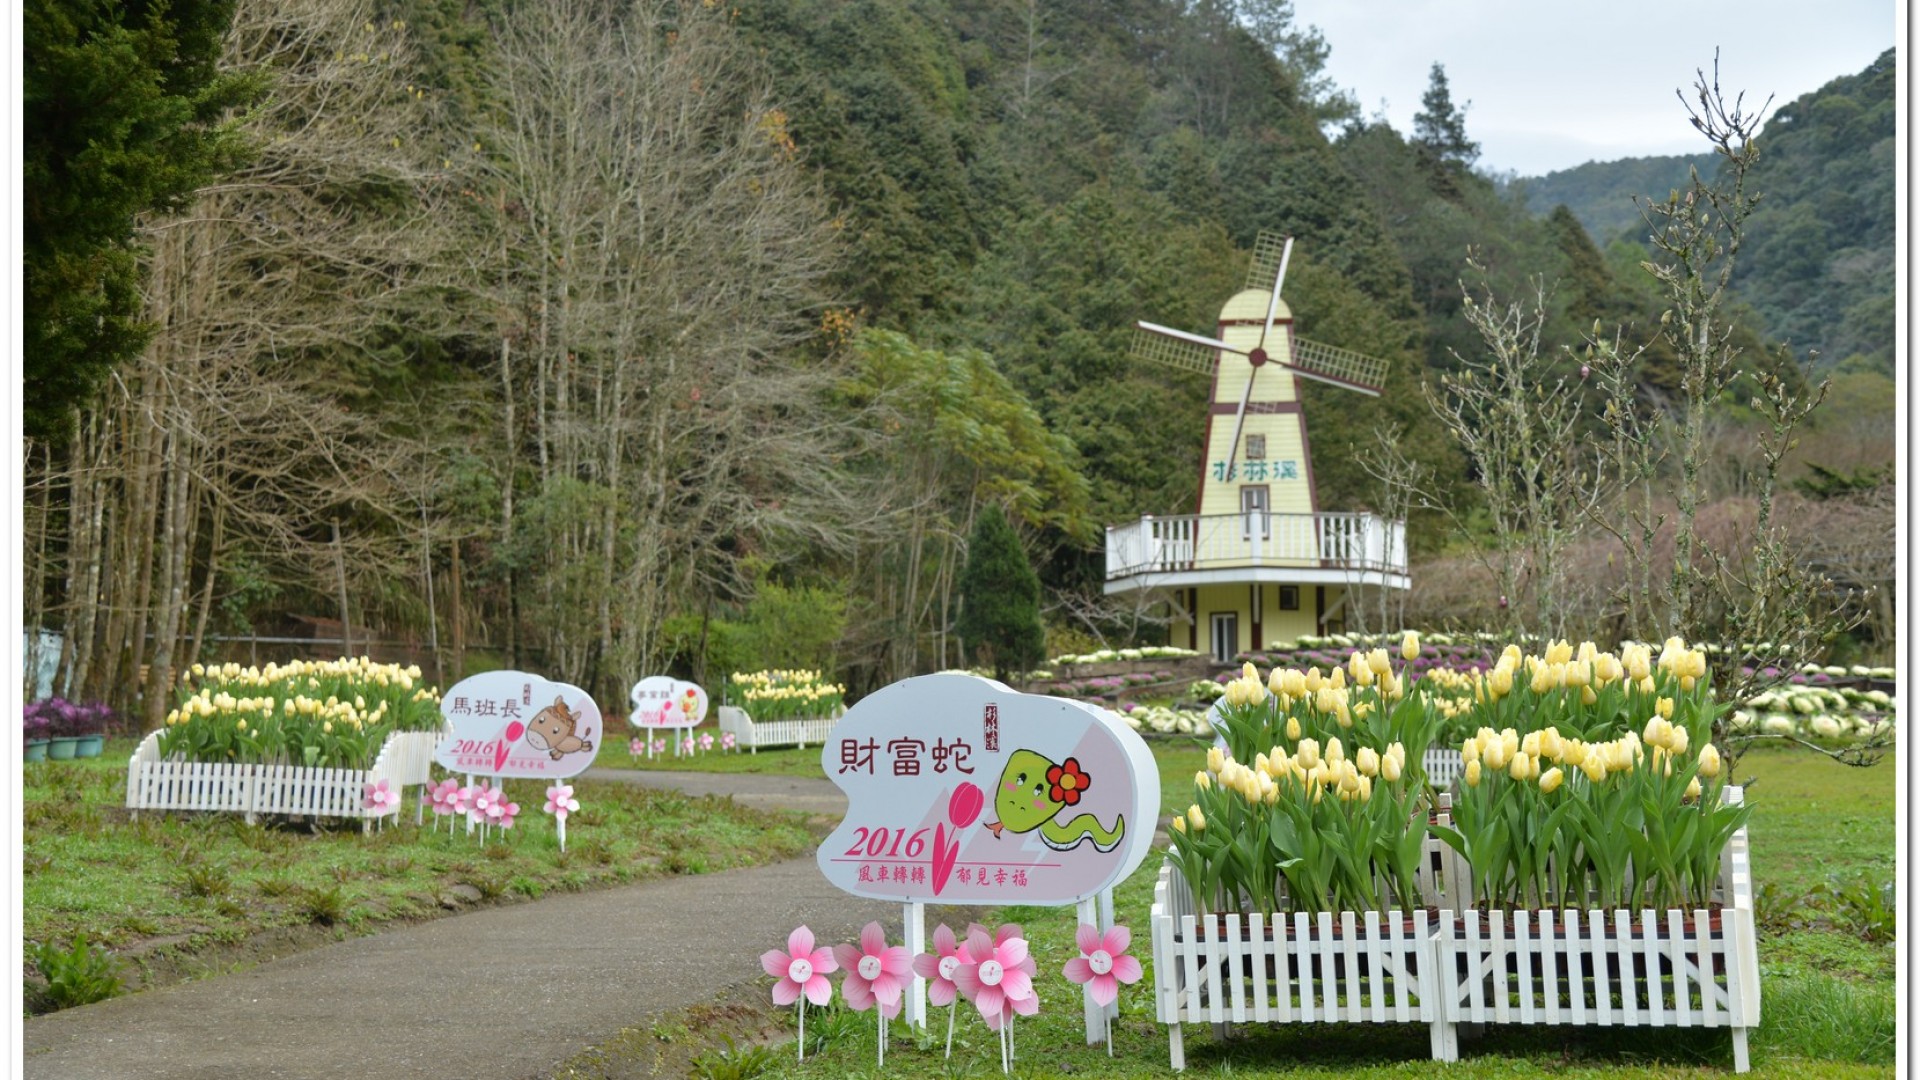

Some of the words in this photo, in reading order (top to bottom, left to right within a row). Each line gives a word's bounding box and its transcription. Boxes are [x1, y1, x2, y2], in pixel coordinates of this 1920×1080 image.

[450, 697, 522, 719] 馬班長
[450, 738, 495, 755] 2016
[838, 736, 976, 776] 財富蛇
[844, 826, 931, 858] 2016
[858, 865, 926, 885] 風車轉轉
[956, 867, 1029, 887] 郁見幸福
